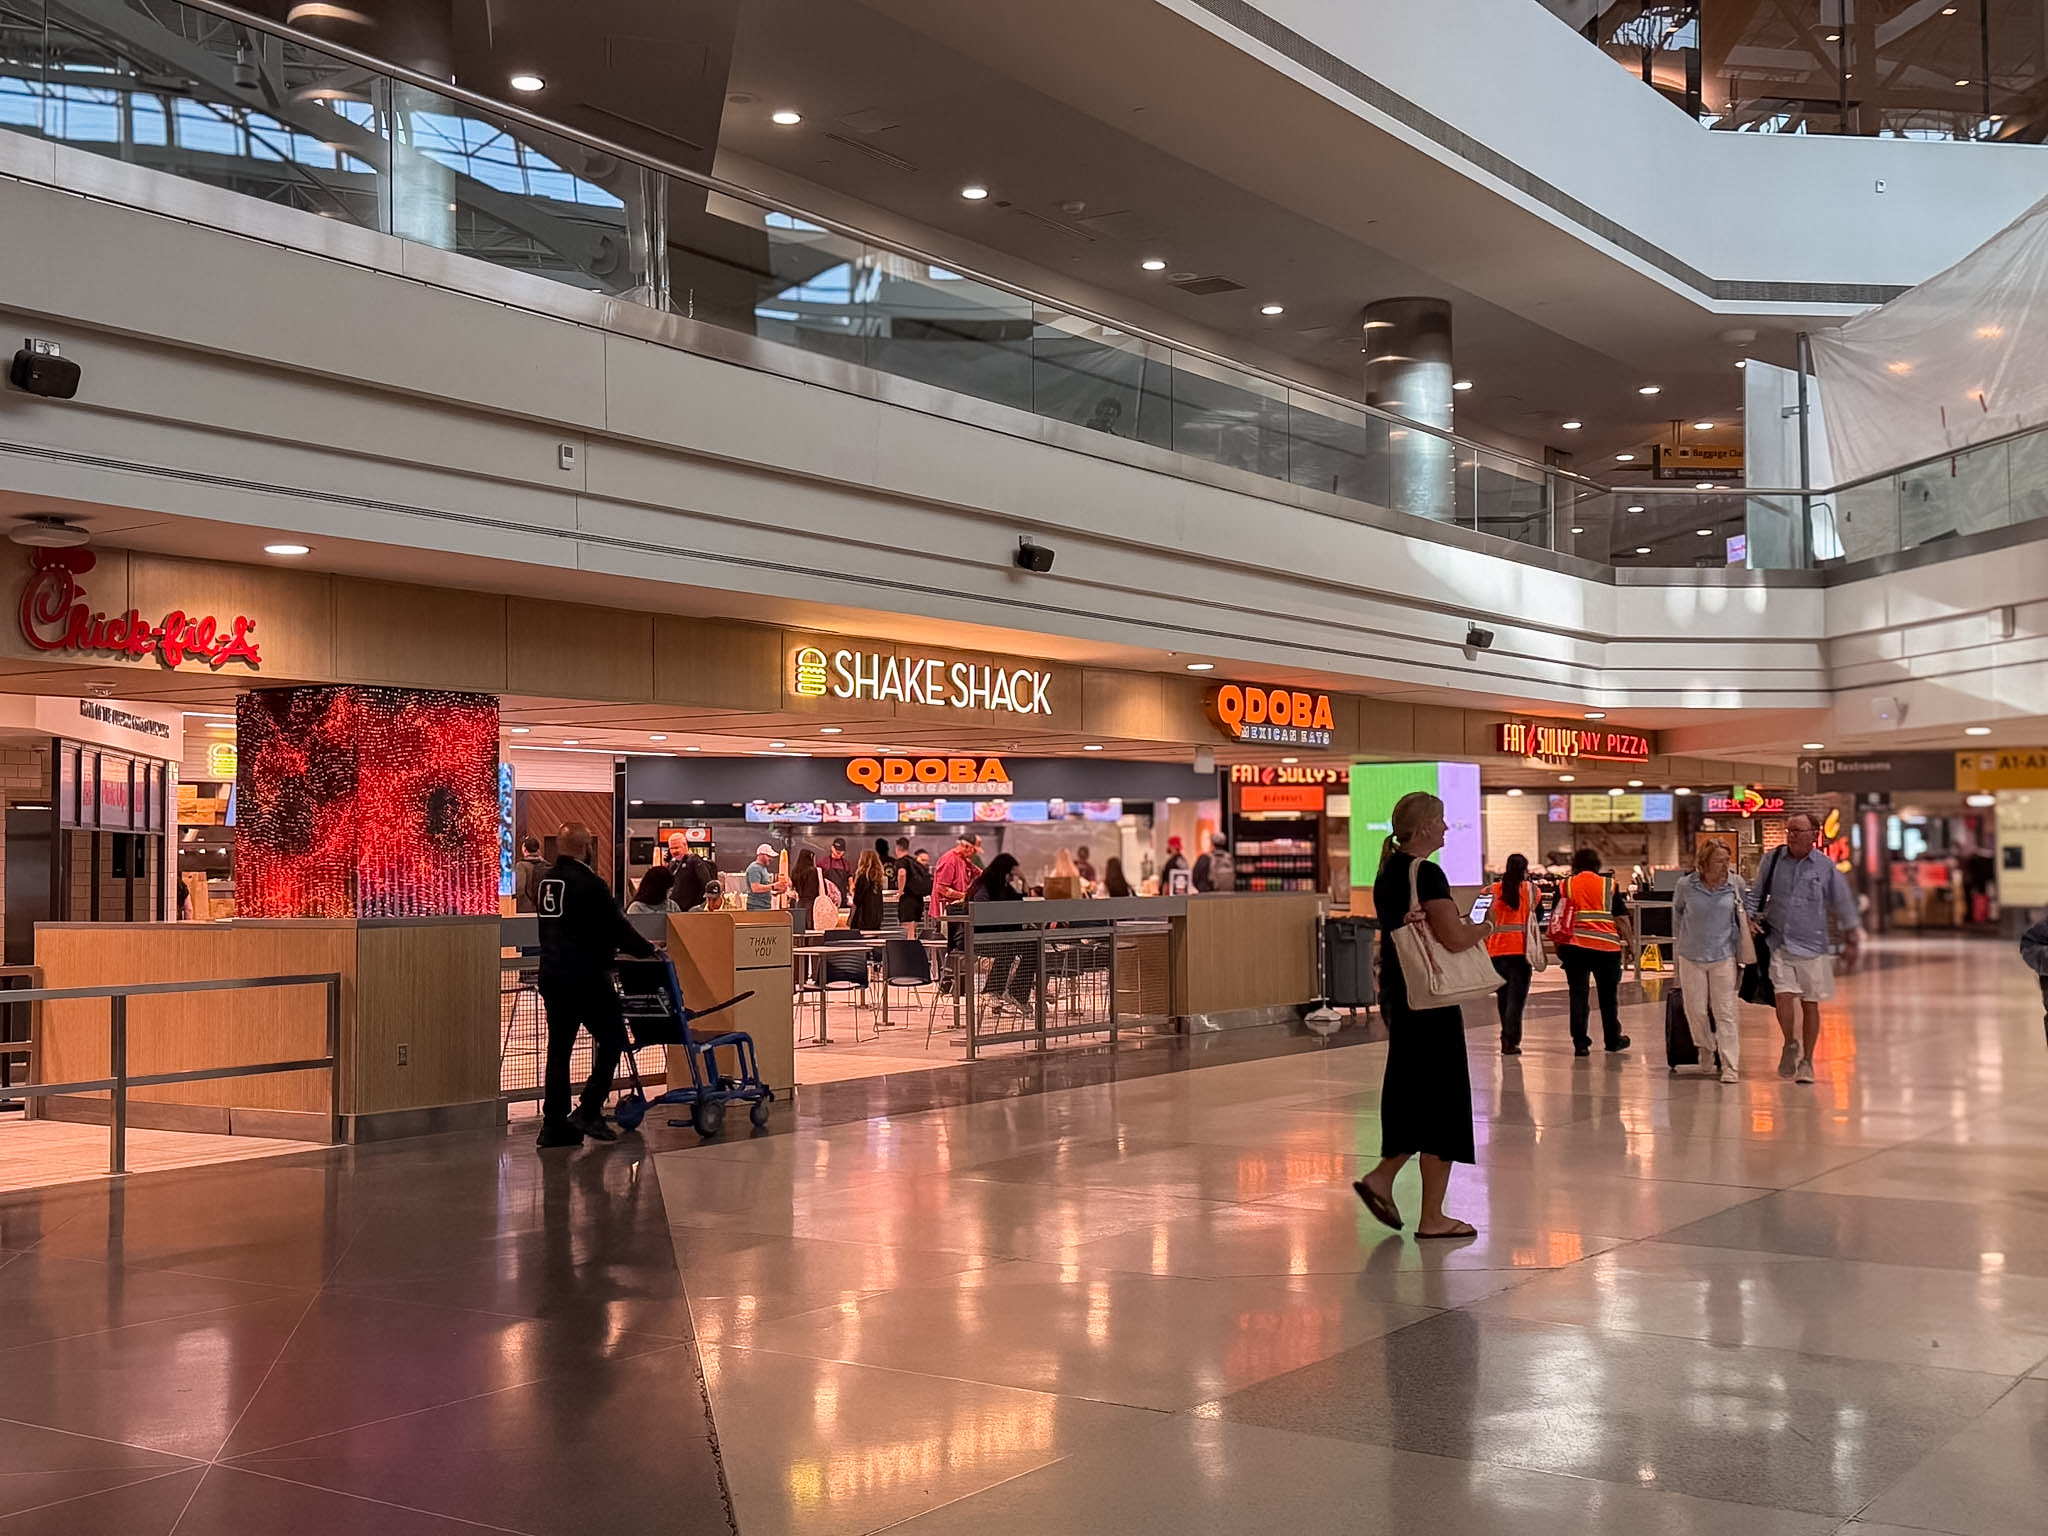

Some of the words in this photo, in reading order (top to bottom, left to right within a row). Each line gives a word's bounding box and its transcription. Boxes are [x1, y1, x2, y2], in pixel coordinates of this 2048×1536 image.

[1693, 448, 1728, 459] Baggage
[20, 562, 262, 667] Chick-fil-A
[834, 650, 946, 706] SHAKE
[951, 662, 1052, 715] SHACK
[1218, 684, 1335, 736] QDOBA
[1241, 726, 1297, 742] MEXICAN
[1301, 731, 1330, 745] EATS
[1503, 724, 1526, 754] FAT
[1581, 731, 1600, 751] NY
[1607, 734, 1649, 755] PIZZA
[847, 758, 1009, 793] QDOBA
[1836, 760, 1892, 772] Restrooms
[1708, 798, 1741, 809] PICK
[1765, 798, 1784, 809] UP
[750, 936, 777, 946] THANK
[754, 947, 772, 957] YOU
